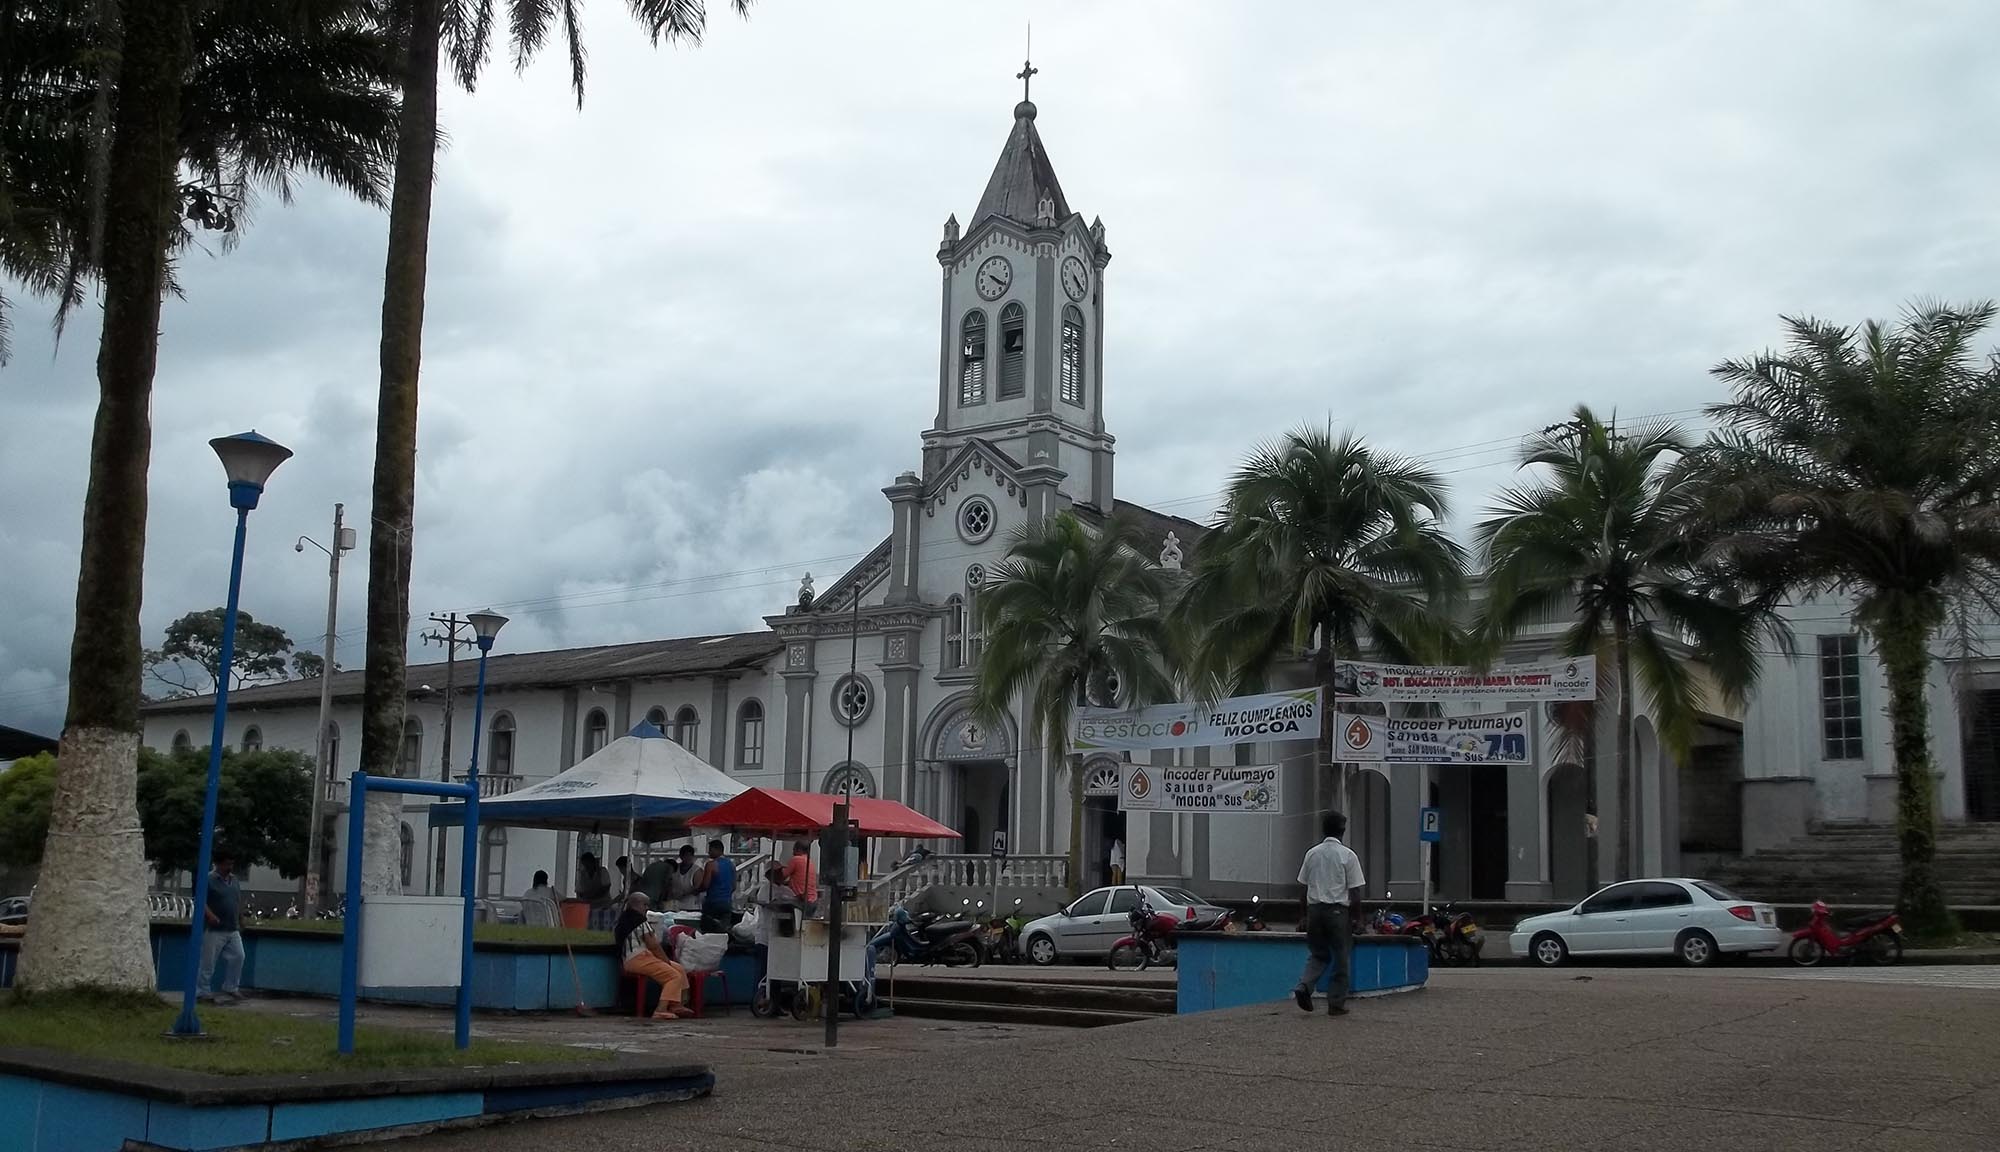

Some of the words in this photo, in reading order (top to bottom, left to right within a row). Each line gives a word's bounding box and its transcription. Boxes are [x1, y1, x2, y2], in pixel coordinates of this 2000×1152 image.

[1404, 676, 1451, 688] EDUCATIVA
[1554, 680, 1590, 688] incoder
[1209, 711, 1238, 727] FELIZ
[1240, 703, 1313, 724] CUMPLEAÑOS
[1224, 721, 1300, 737] MOCOA
[1387, 718, 1445, 730] Incoder
[1448, 717, 1523, 732] Putumayo
[1387, 730, 1438, 742] Saluda
[1484, 733, 1526, 760] 70
[1464, 751, 1484, 762] Sus
[1163, 768, 1212, 781] Incoder
[1213, 768, 1275, 784] Putumayo
[1165, 782, 1214, 793] Saluda
[1176, 795, 1216, 807] MOCOA
[1224, 794, 1242, 806] Sus
[1427, 812, 1436, 830] P
